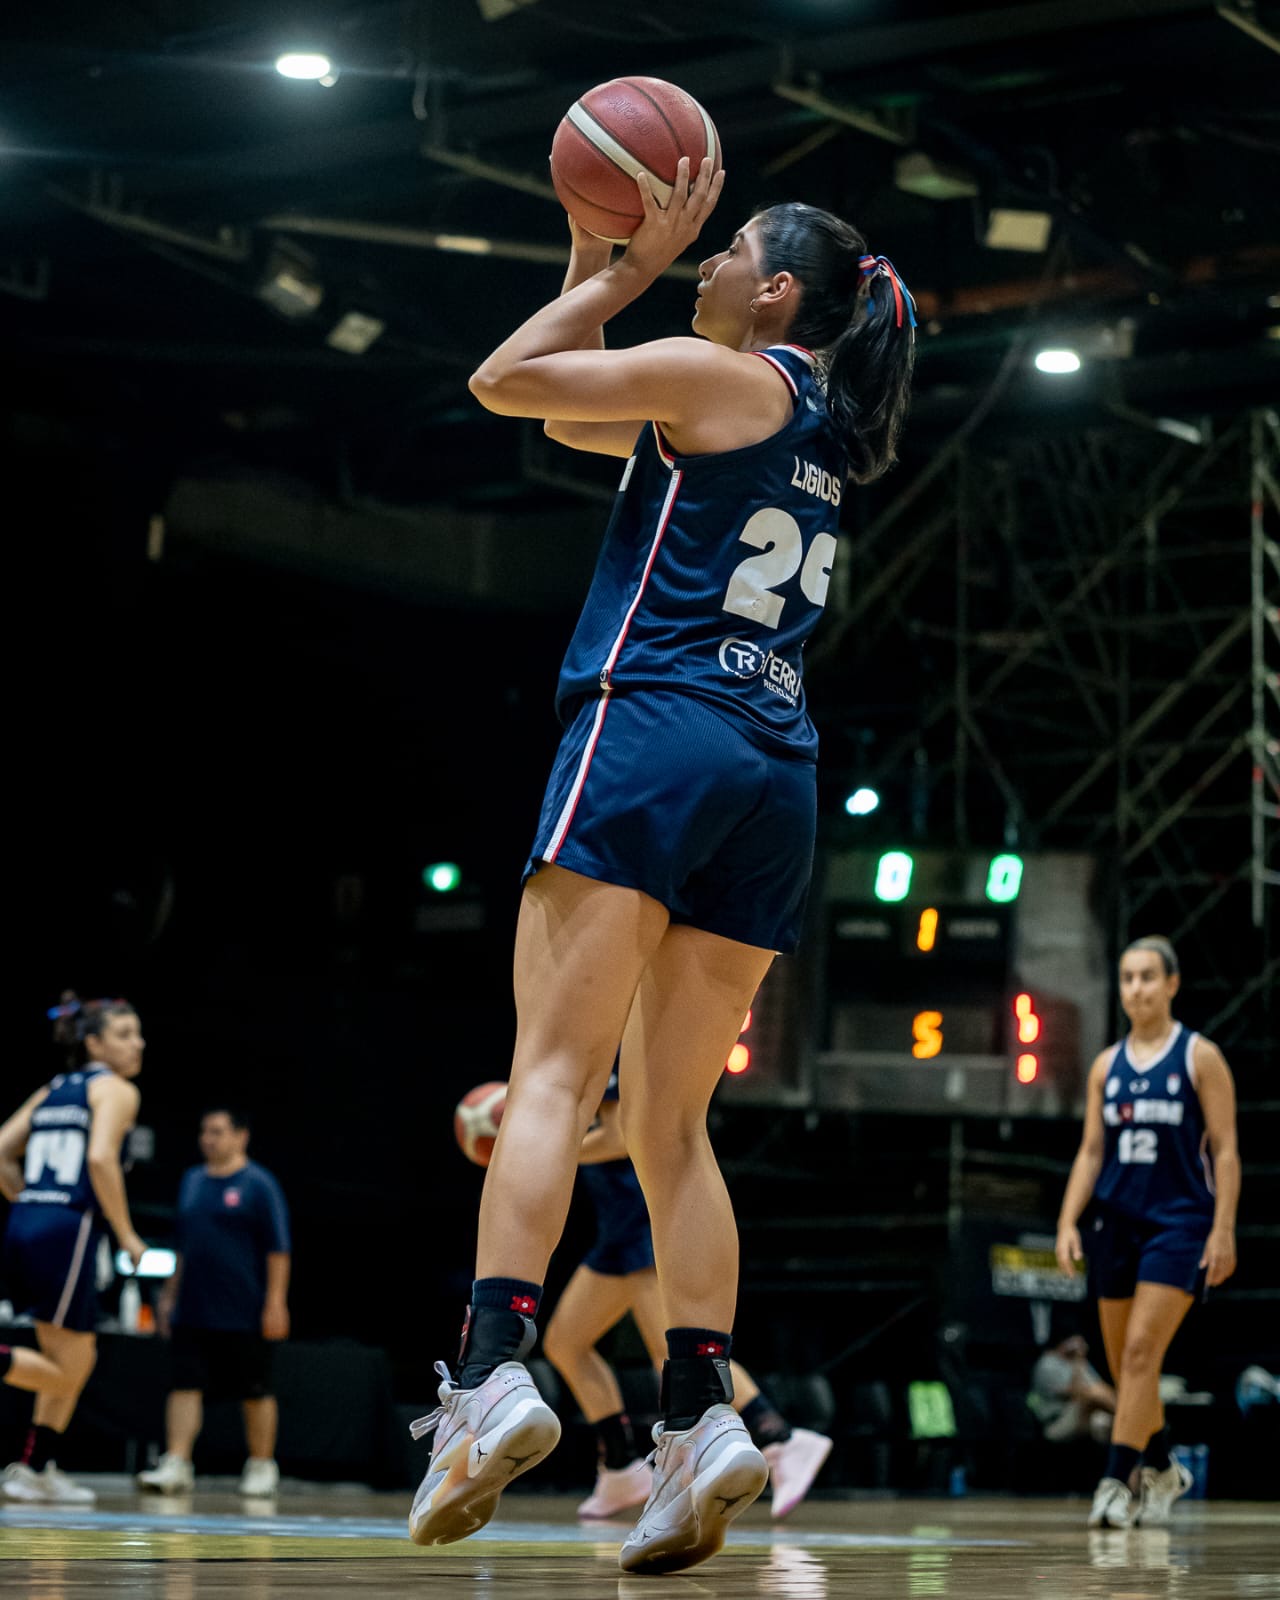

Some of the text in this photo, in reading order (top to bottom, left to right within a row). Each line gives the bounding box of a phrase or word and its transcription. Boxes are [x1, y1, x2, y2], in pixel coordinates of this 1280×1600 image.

[791, 455, 841, 507] LIGIOS
[874, 851, 913, 902] 0
[985, 854, 1024, 902] 0
[25, 1130, 85, 1186] 14
[1118, 1128, 1158, 1164] 12
